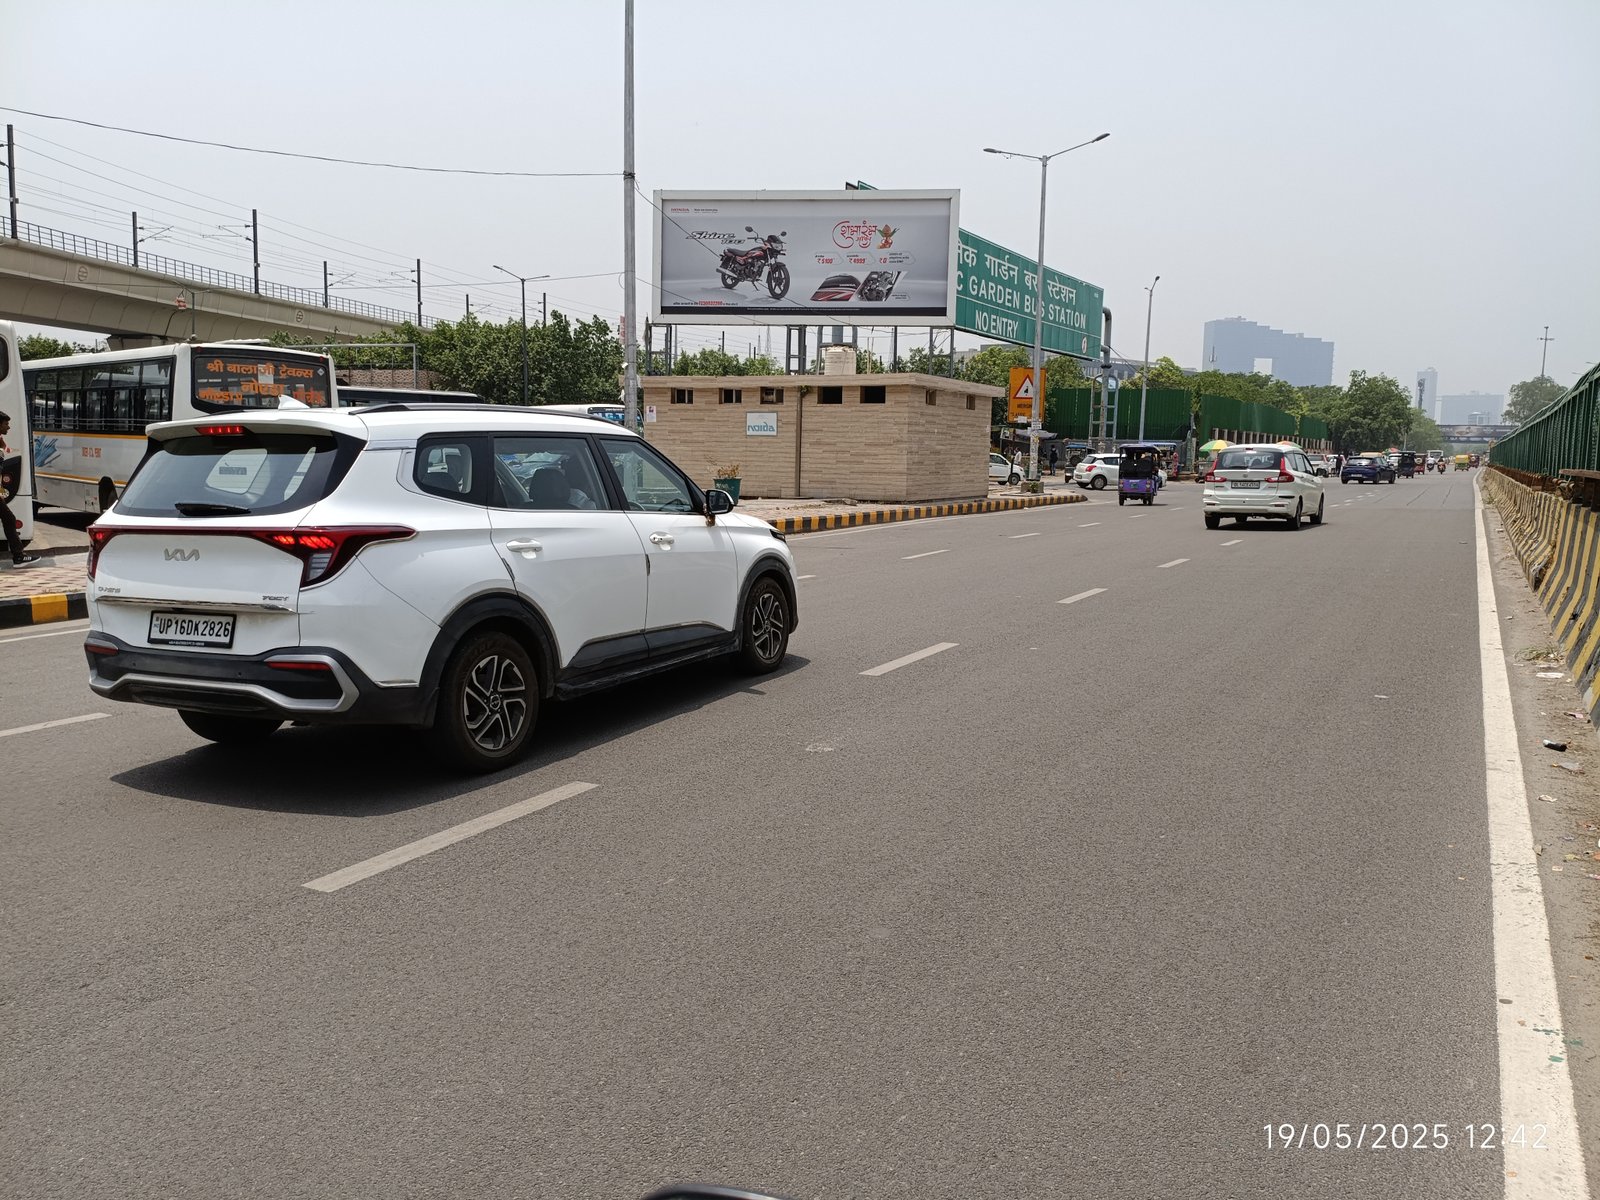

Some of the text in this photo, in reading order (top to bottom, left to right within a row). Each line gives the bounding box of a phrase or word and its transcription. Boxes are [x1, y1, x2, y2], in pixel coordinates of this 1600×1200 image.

[685, 231, 736, 240] Shine
[984, 254, 1019, 285] गार्डन
[1047, 275, 1077, 305] स्टेशन
[969, 276, 1020, 309] GARDEN
[1048, 303, 1087, 330] STATION
[975, 309, 1019, 339] NO ENTRY
[206, 359, 225, 373] श्री
[164, 548, 200, 562] KIA
[158, 617, 231, 638] UP16DK2826
